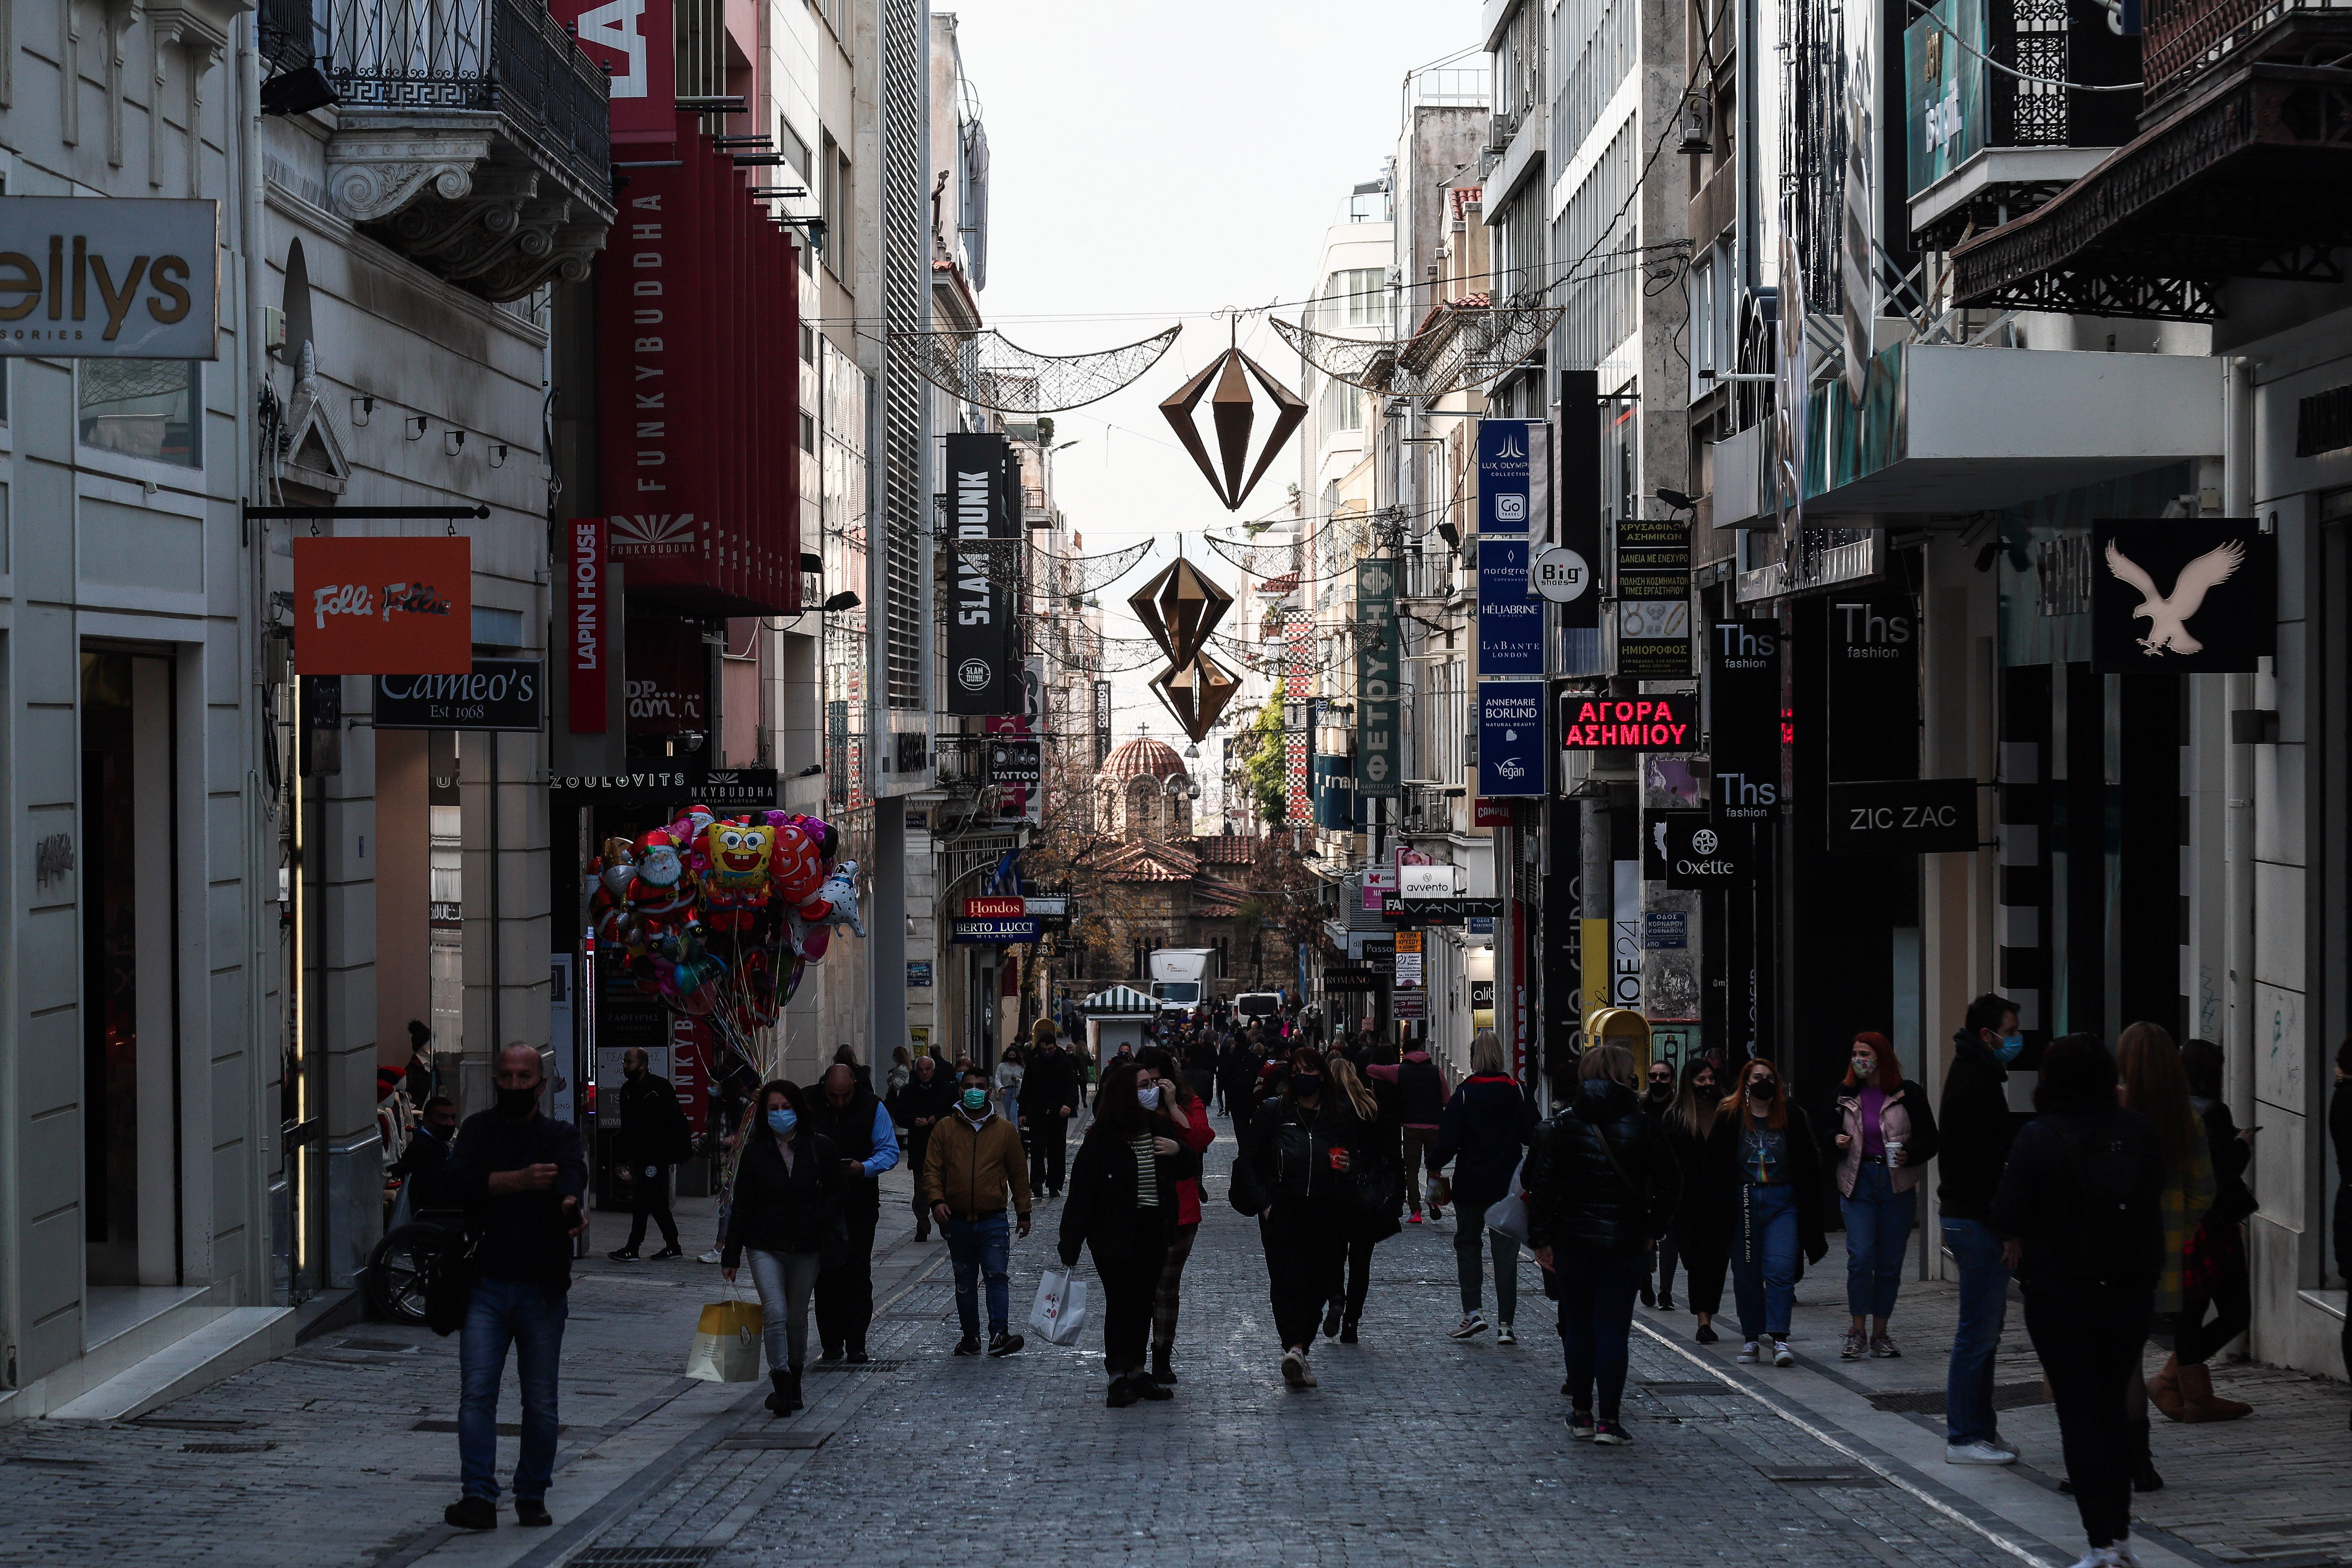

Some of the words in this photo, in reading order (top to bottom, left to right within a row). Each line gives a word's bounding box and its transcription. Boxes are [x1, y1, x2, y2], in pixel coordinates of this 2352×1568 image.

[633, 194, 666, 491] FUNKYBUDDHA
[958, 471, 989, 542] DUNK
[1501, 499, 1520, 511] Go
[611, 544, 695, 555] FUNKYBUDDHA
[577, 524, 596, 598] HOUSE
[1620, 555, 1645, 563] ΔΑΝΕΙΑ
[1658, 554, 1688, 562] ΕΝΕΧΥΡΟ
[1542, 564, 1579, 583] Big
[1620, 577, 1645, 585] ΠΩΛΗΣΗ
[1647, 577, 1689, 585] ΚΟΣΜΗΜΑΤΩΝ
[958, 553, 990, 625] SLAM
[313, 584, 373, 629] Folli
[381, 582, 451, 622] Follie
[1482, 603, 1538, 614] HÉLIABRINE
[1836, 603, 1910, 644] Ths
[578, 605, 596, 669] LAPIN
[1716, 624, 1776, 656] Ths
[1622, 645, 1687, 655] ΗΜΙΟΡΟΦΟΣ
[1848, 647, 1899, 659] fashion
[1725, 659, 1766, 669] fashion
[430, 705, 450, 718] Est
[455, 705, 484, 721] 1968
[1098, 683, 1106, 728] COSMOS
[1486, 707, 1537, 718] BÖRLIND
[1579, 702, 1673, 722] ΑΓΟΡΑ
[1566, 723, 1687, 745] ΑΣΗΜΙΟΥ
[992, 771, 1038, 779] TATTOO
[1493, 758, 1525, 779] Vegan
[549, 772, 684, 789] ZOULOVITS
[691, 787, 773, 797] NKYBUDDHA
[1716, 774, 1776, 805] Ths
[1478, 807, 1509, 818] CAMPER
[1726, 808, 1767, 817] fashion
[1850, 808, 1894, 830] ZIC
[1902, 806, 1956, 829] ZAC
[1676, 859, 1734, 874] Oxétte
[1407, 883, 1448, 891] avvento
[970, 899, 1020, 914] Hondos
[1406, 902, 1502, 913] VANITY
[956, 922, 993, 932] BERTO
[1000, 922, 1033, 932] LUCCI
[1326, 976, 1370, 985] ROMANO
